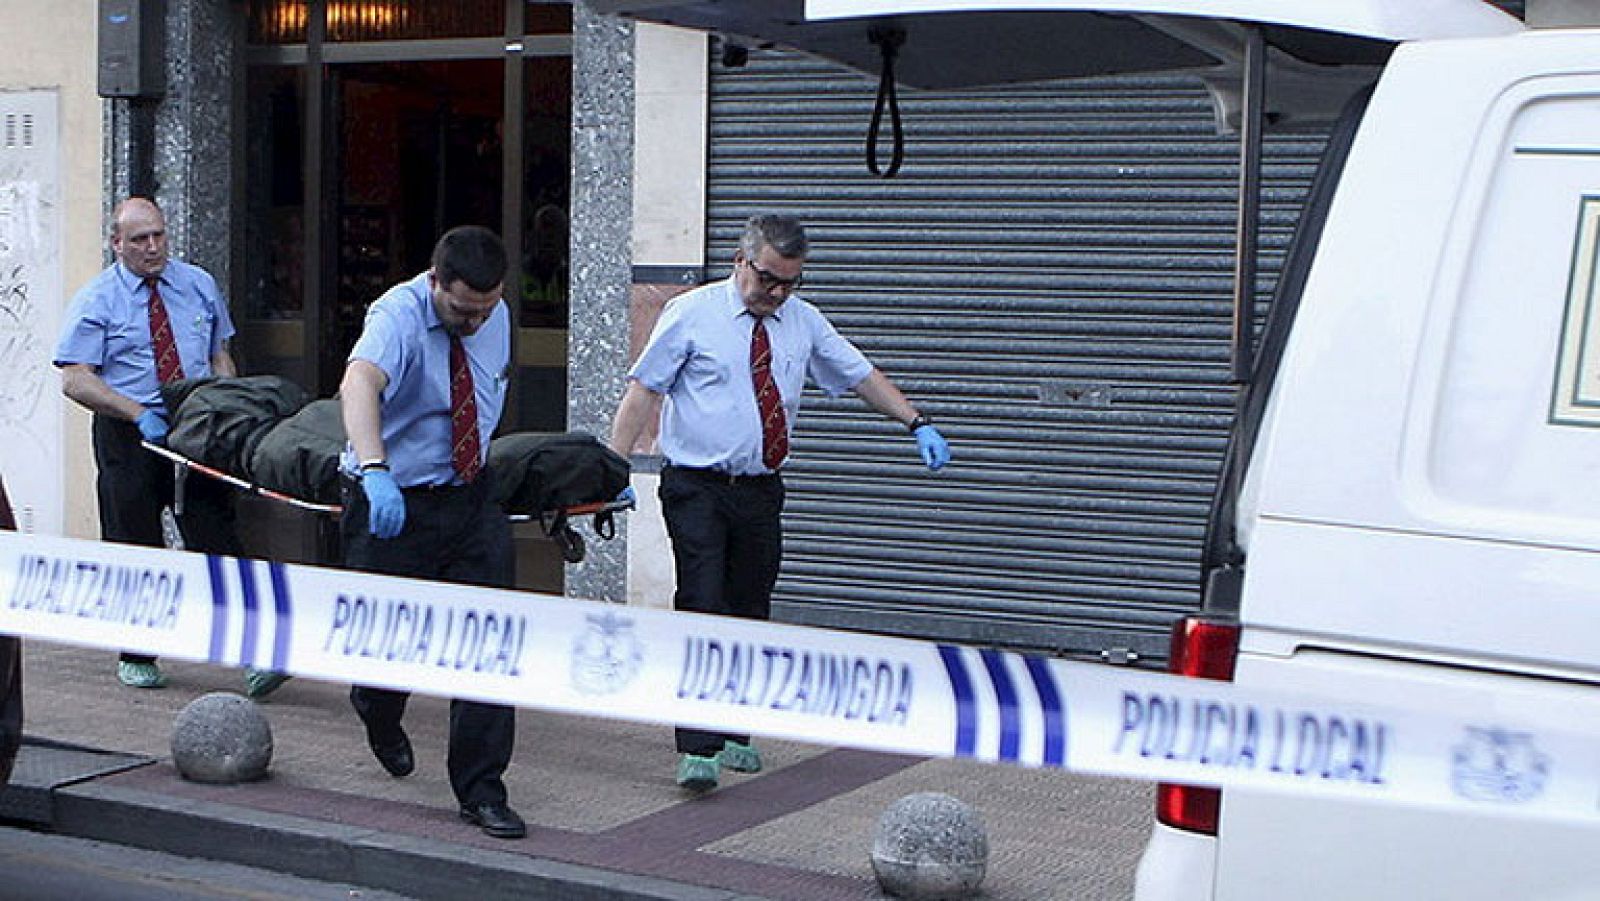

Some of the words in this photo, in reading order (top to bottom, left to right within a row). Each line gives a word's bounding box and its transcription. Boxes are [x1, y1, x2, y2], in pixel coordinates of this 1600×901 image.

[10, 555, 184, 628] UDALTZAINGOA
[324, 594, 433, 665] POLICIA
[436, 607, 528, 677] LOCAL
[677, 637, 911, 726] UDALTZAINGOA
[1115, 692, 1259, 768] POLICIA
[1268, 711, 1388, 784] LOCAL
